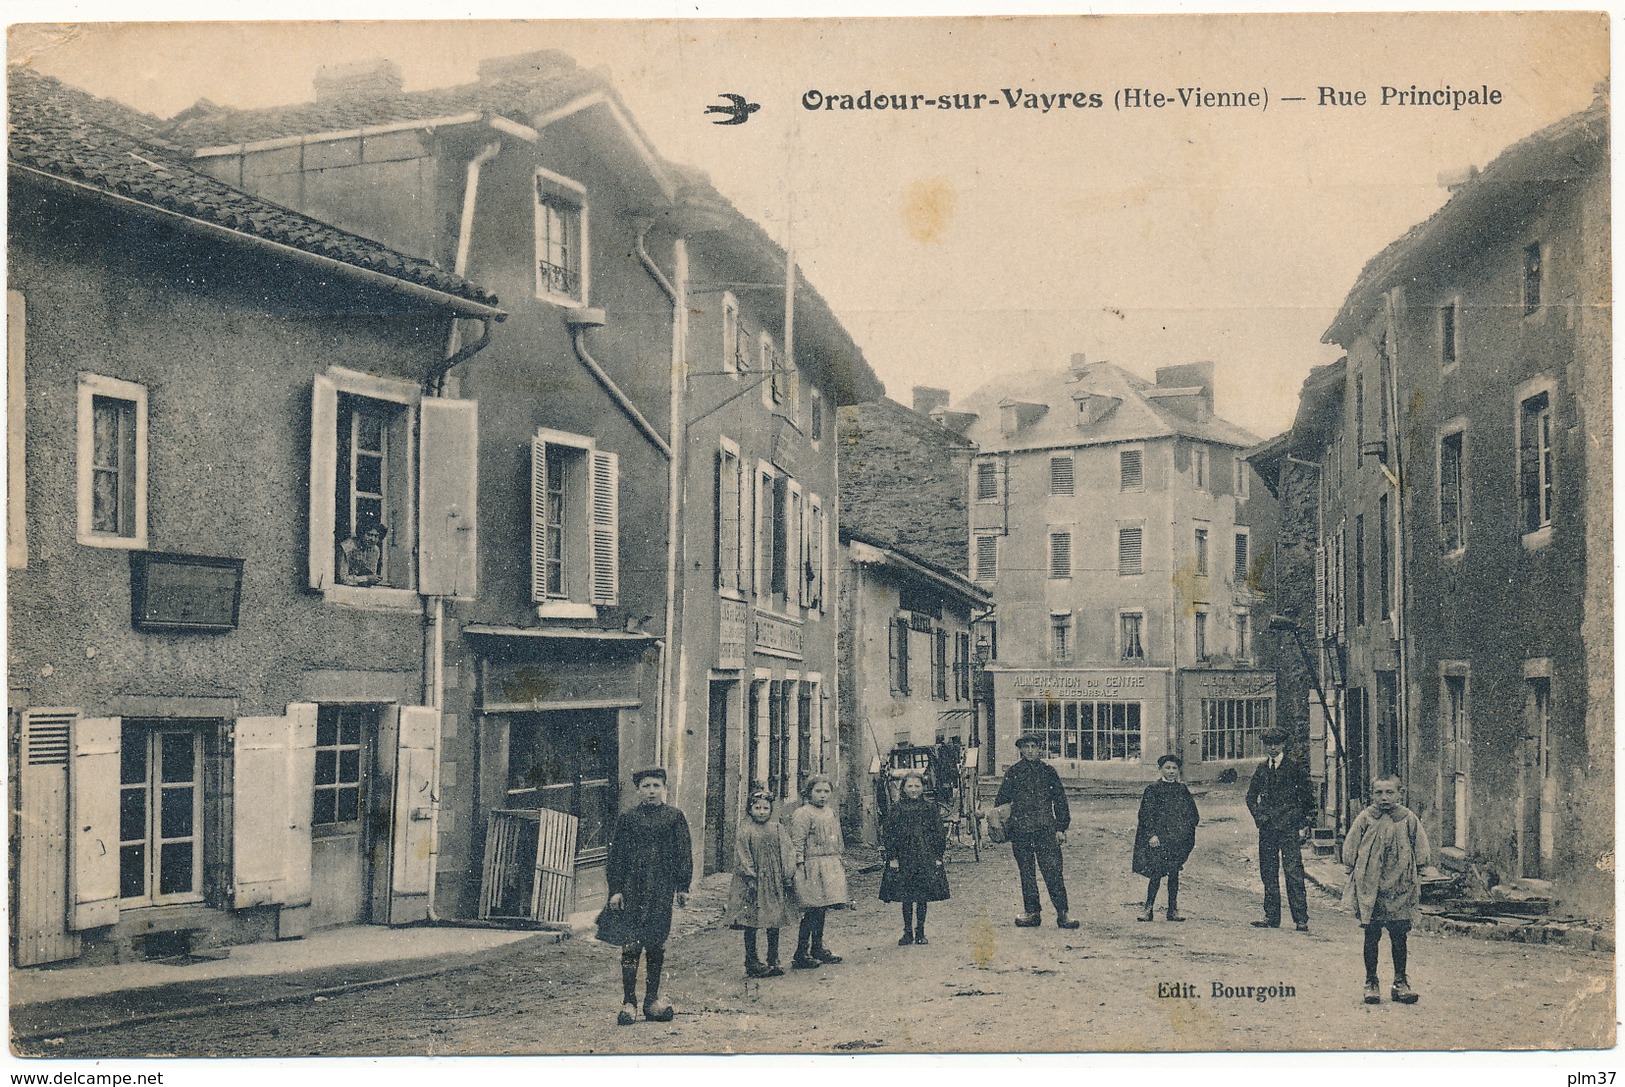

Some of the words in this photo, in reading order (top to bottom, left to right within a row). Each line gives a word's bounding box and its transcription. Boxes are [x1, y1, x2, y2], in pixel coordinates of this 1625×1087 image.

[1013, 675, 1081, 688] ALIMENTATION
[1105, 675, 1145, 688] CENTRE
[1058, 688, 1119, 698] SUCCURSALE
